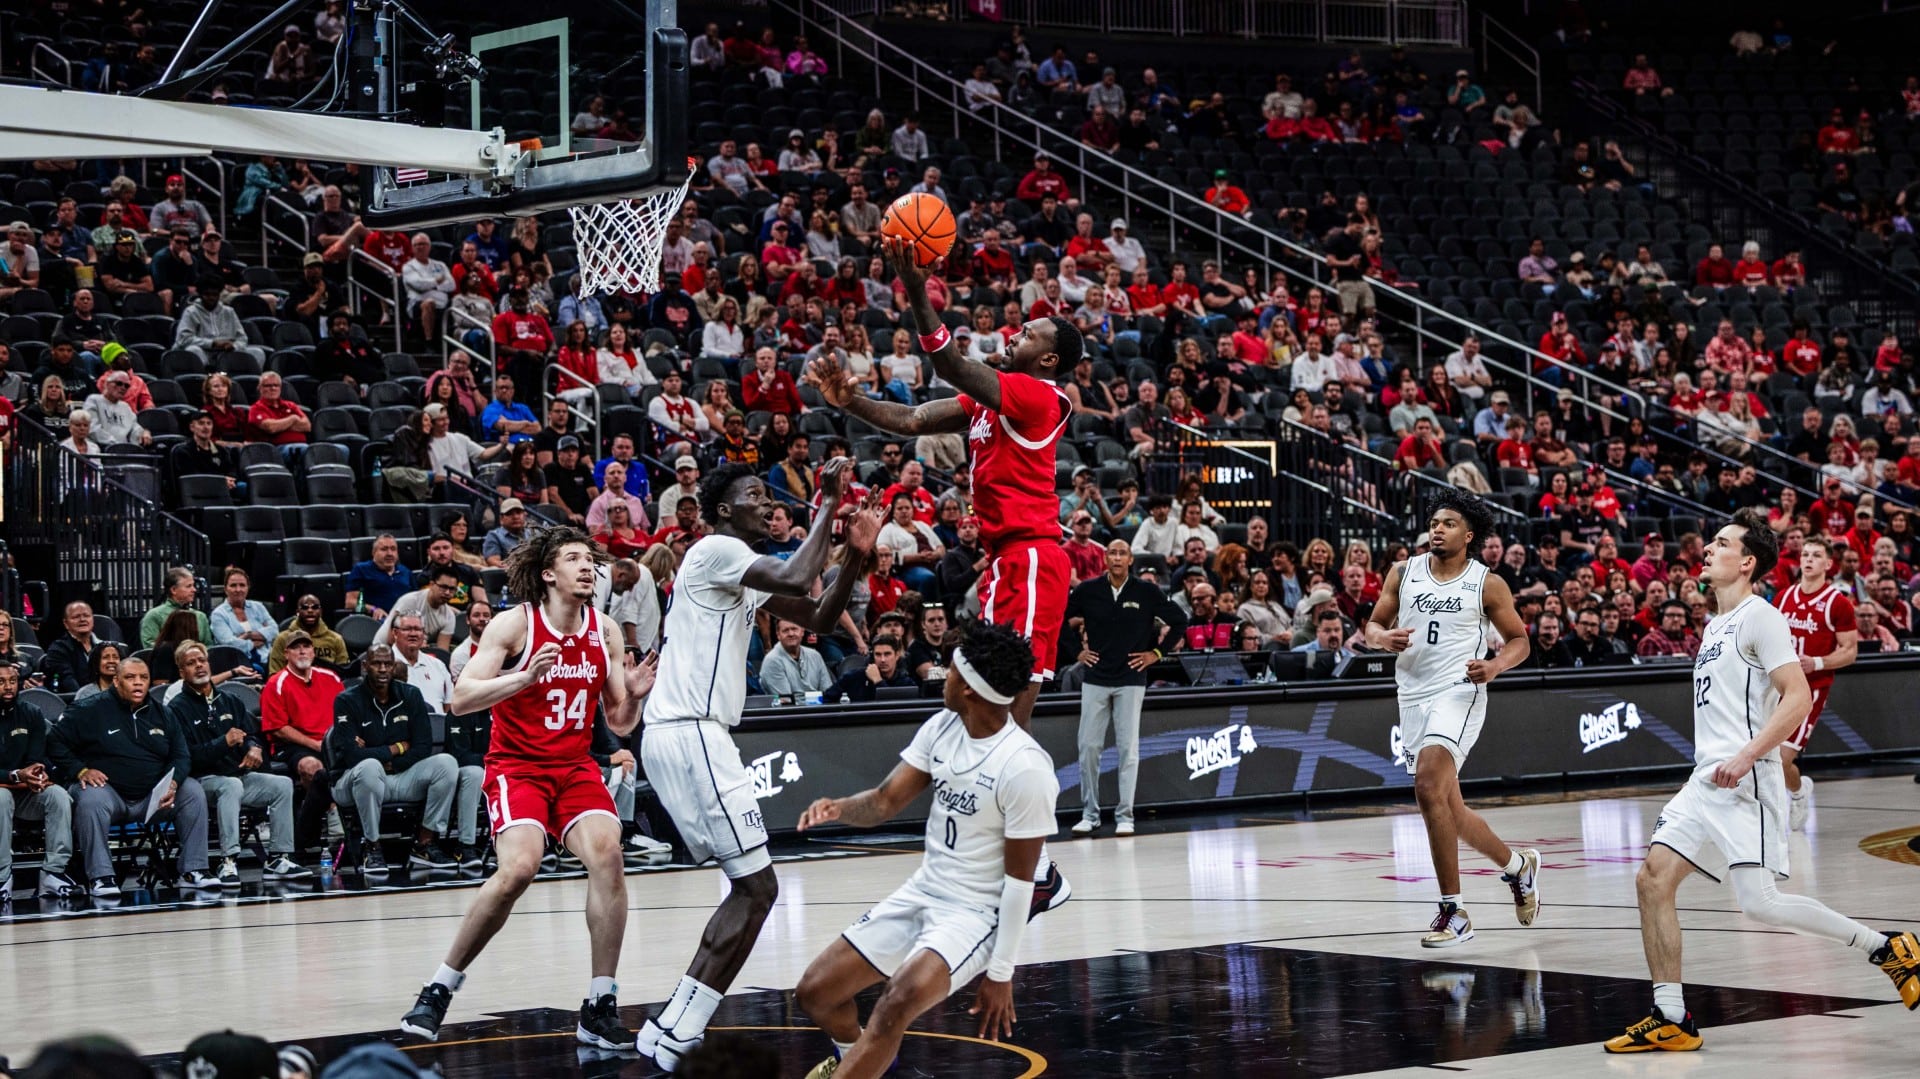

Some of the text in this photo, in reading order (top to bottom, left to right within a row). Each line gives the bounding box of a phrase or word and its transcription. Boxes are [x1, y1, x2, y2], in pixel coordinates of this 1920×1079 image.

[1410, 592, 1464, 615] Knights
[1427, 620, 1440, 645] 6
[544, 688, 588, 730] 34
[1696, 675, 1711, 708] 22
[1580, 701, 1628, 754] GHOST
[1186, 724, 1241, 780] GHOST
[933, 778, 980, 816] Knights
[944, 816, 957, 850] 0
